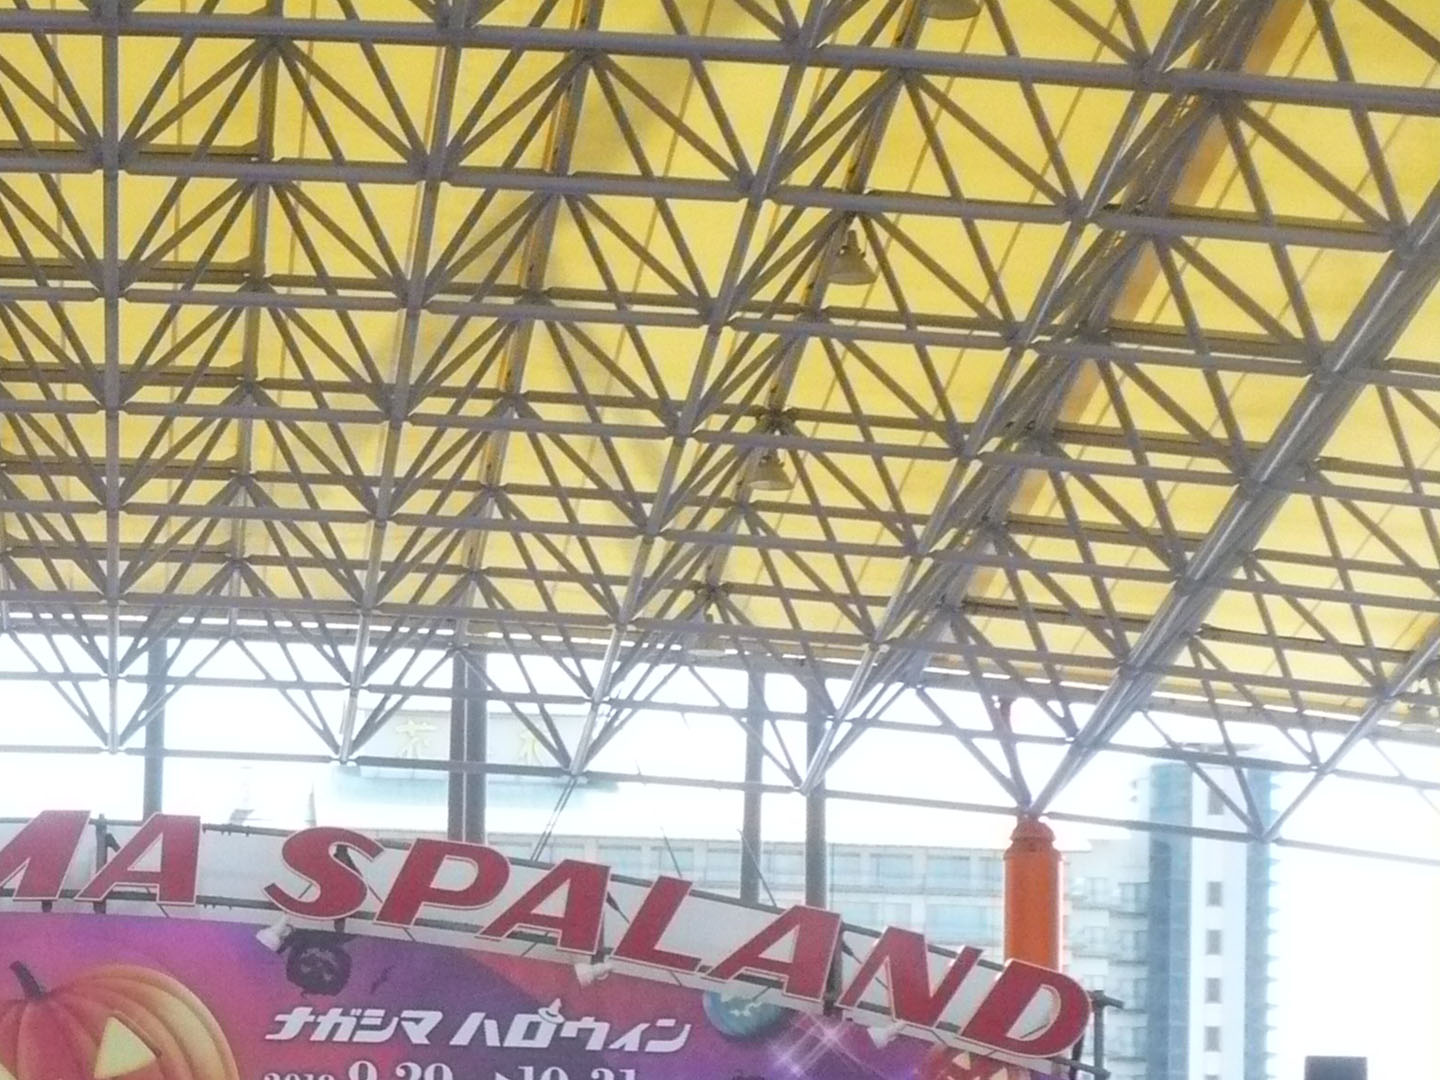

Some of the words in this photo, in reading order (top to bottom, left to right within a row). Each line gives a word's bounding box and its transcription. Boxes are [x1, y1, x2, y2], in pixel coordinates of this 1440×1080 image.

[264, 826, 1093, 1058] SPALAND
[265, 1006, 443, 1044] ナガシマ
[449, 1000, 692, 1053] ハロウィン
